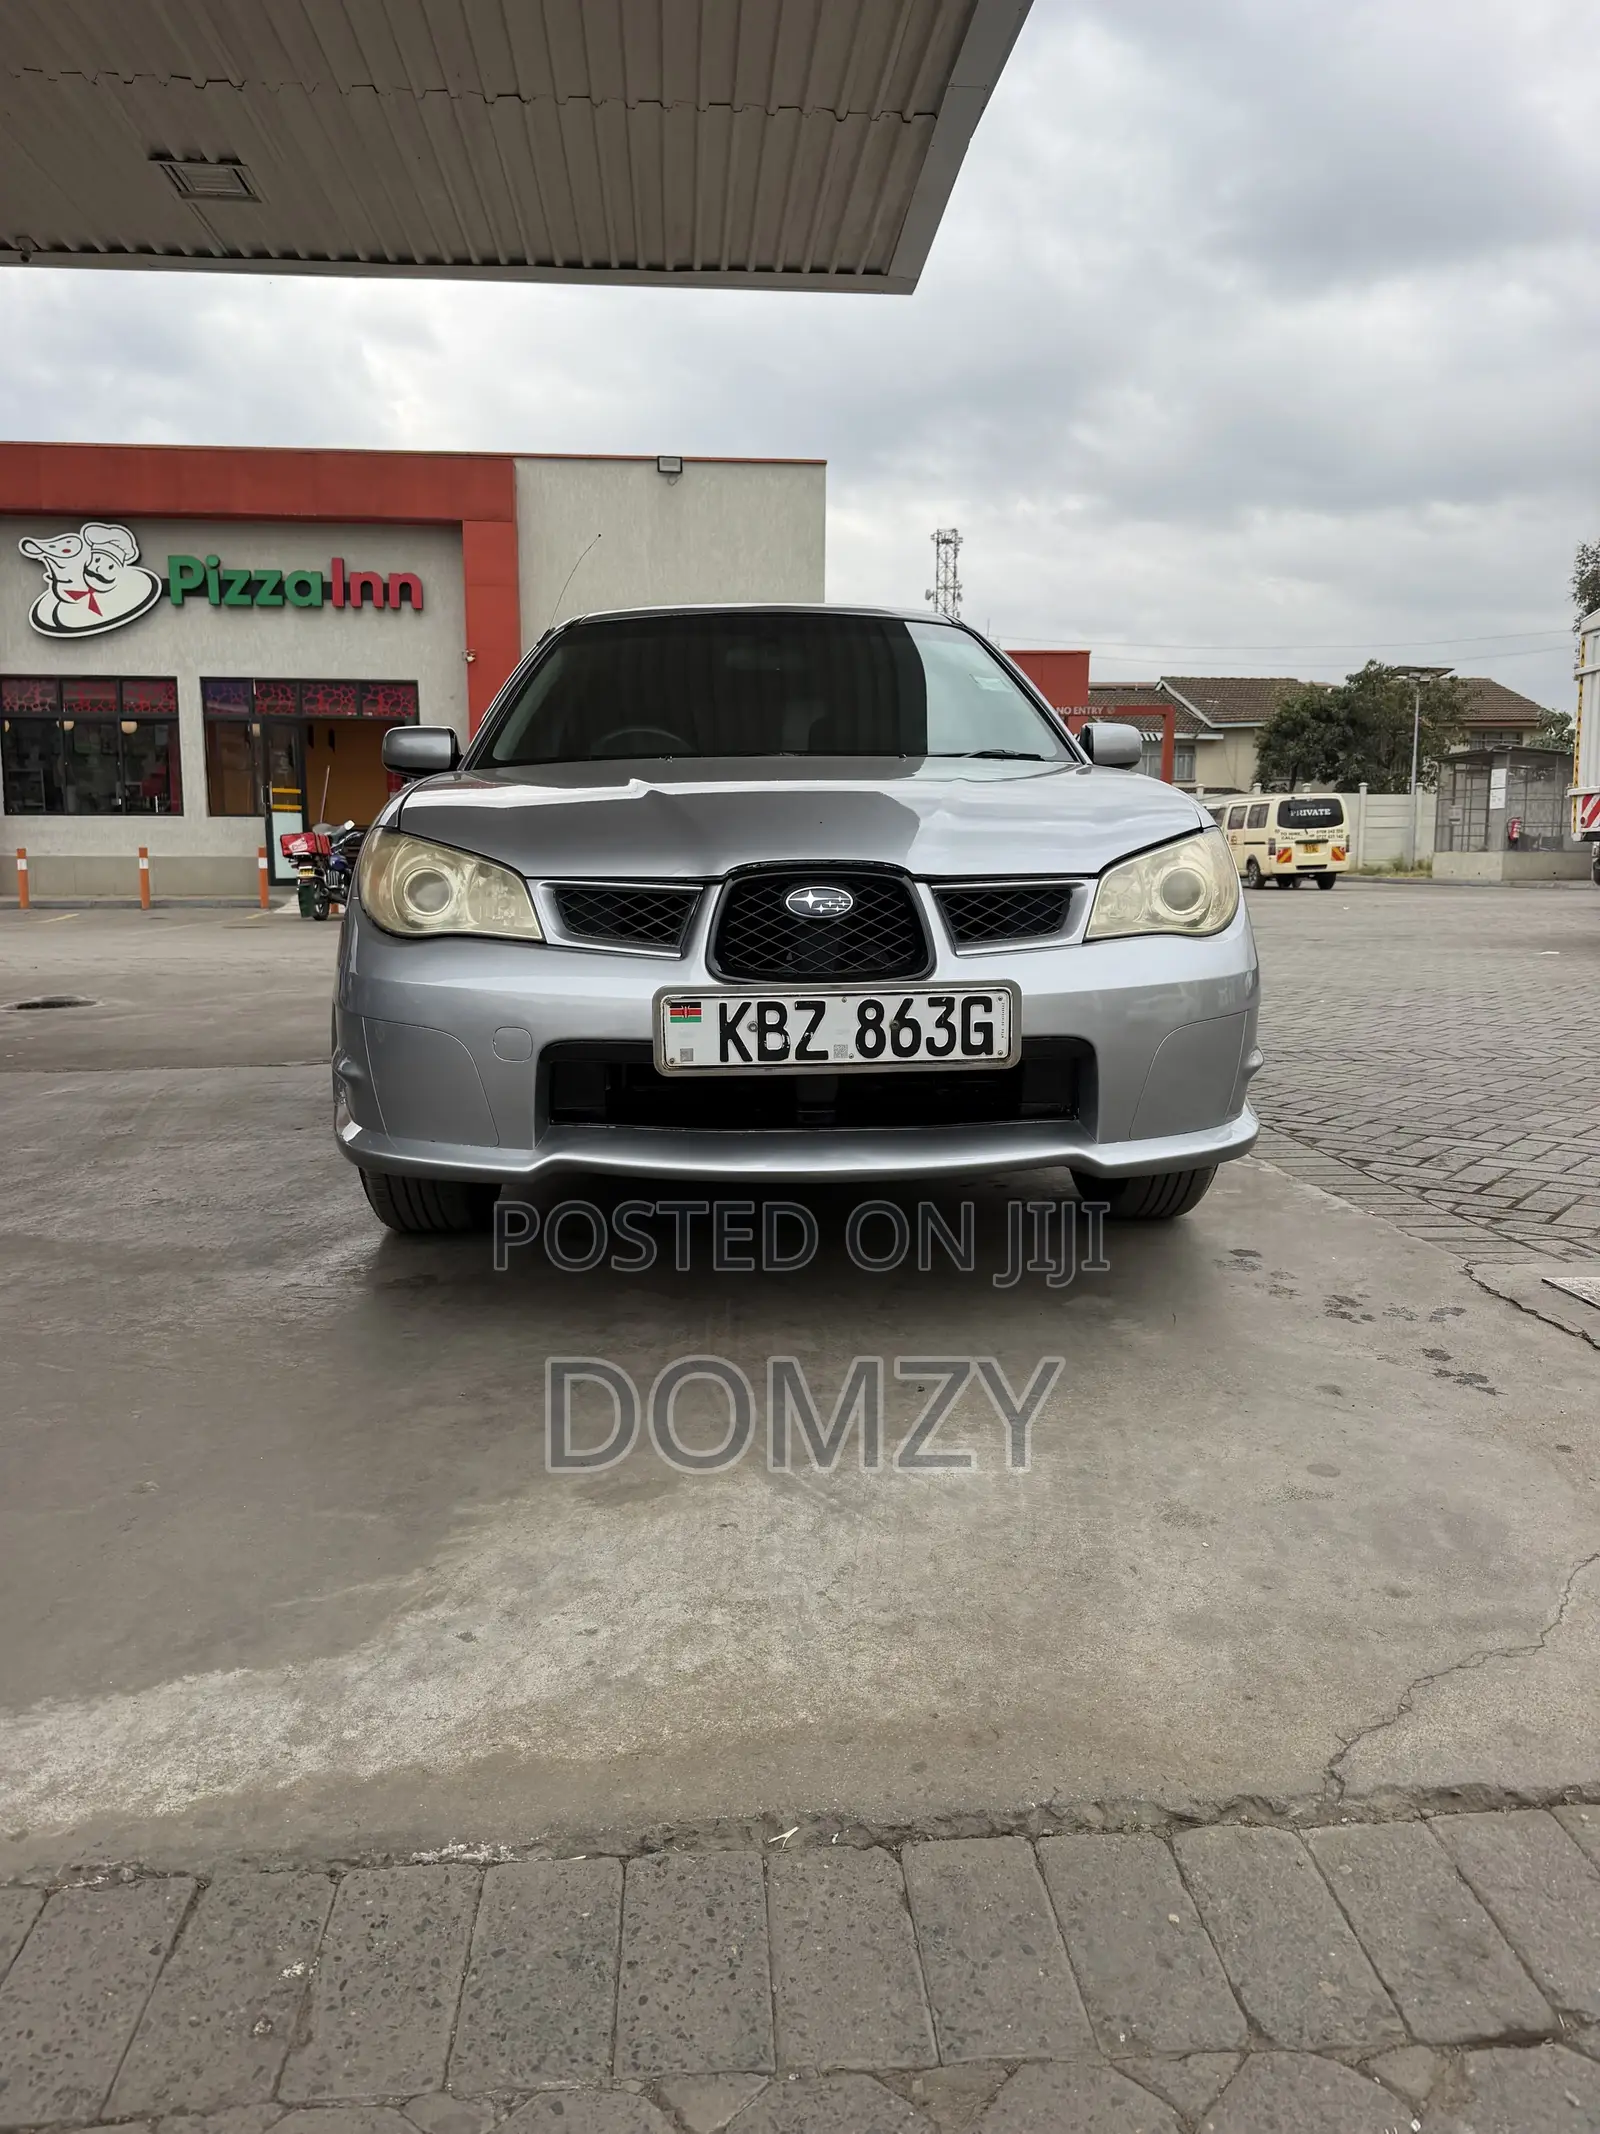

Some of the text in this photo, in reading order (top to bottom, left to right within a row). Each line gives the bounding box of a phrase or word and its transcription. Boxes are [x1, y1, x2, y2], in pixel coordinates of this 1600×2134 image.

[1056, 706, 1104, 714] NO ENTRY
[1290, 808, 1332, 817] PRIVATE
[718, 1000, 830, 1063] KBZ
[855, 995, 994, 1058] 863G
